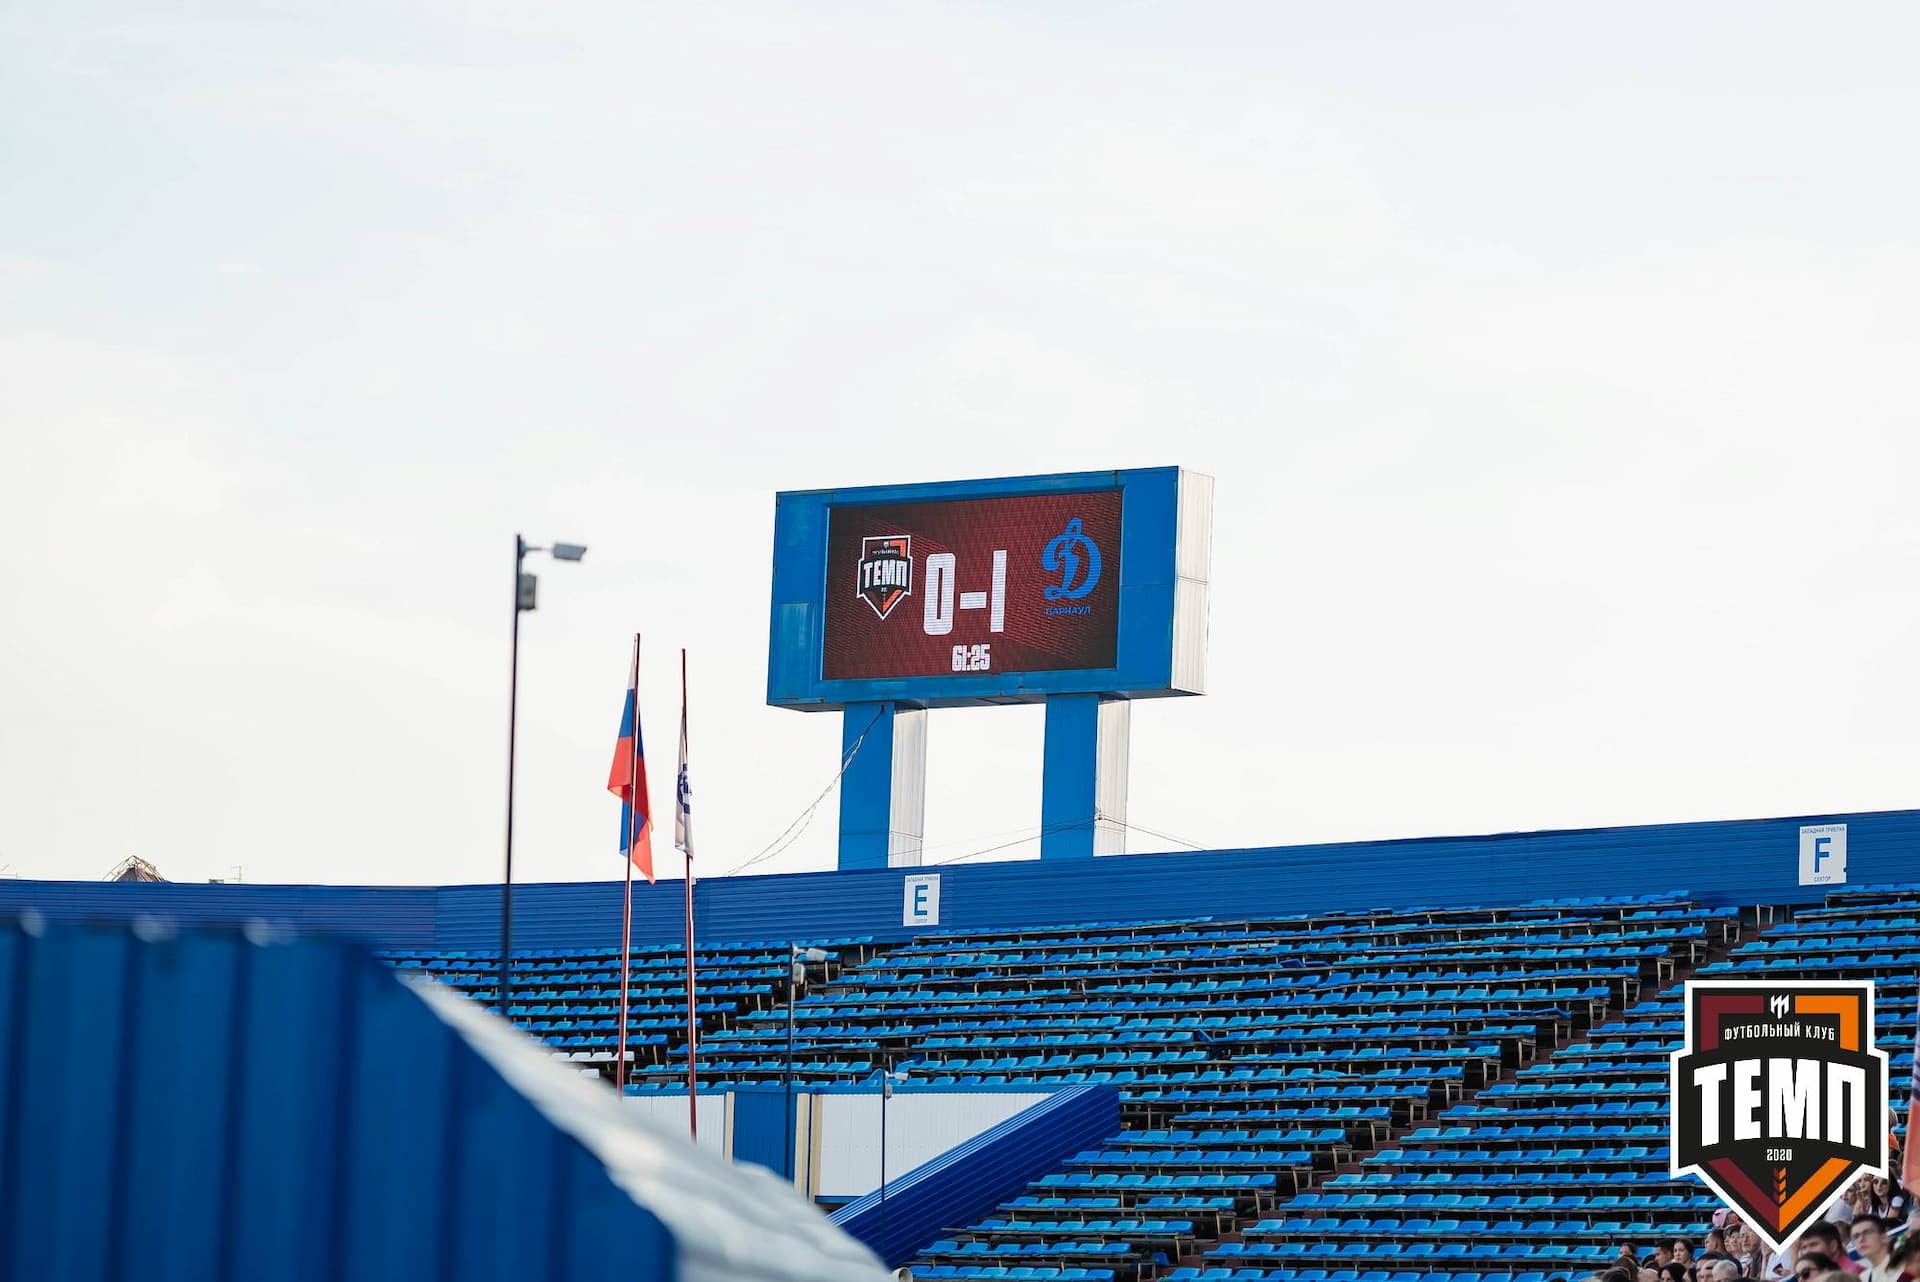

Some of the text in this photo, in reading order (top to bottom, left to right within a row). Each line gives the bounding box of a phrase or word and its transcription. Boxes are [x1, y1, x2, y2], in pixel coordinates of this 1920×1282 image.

[863, 560, 908, 588] ТЕМП
[1045, 606, 1091, 616] БАРНАУЛ
[952, 643, 991, 672] 61:25
[1814, 837, 1832, 873] F
[914, 884, 929, 916] E
